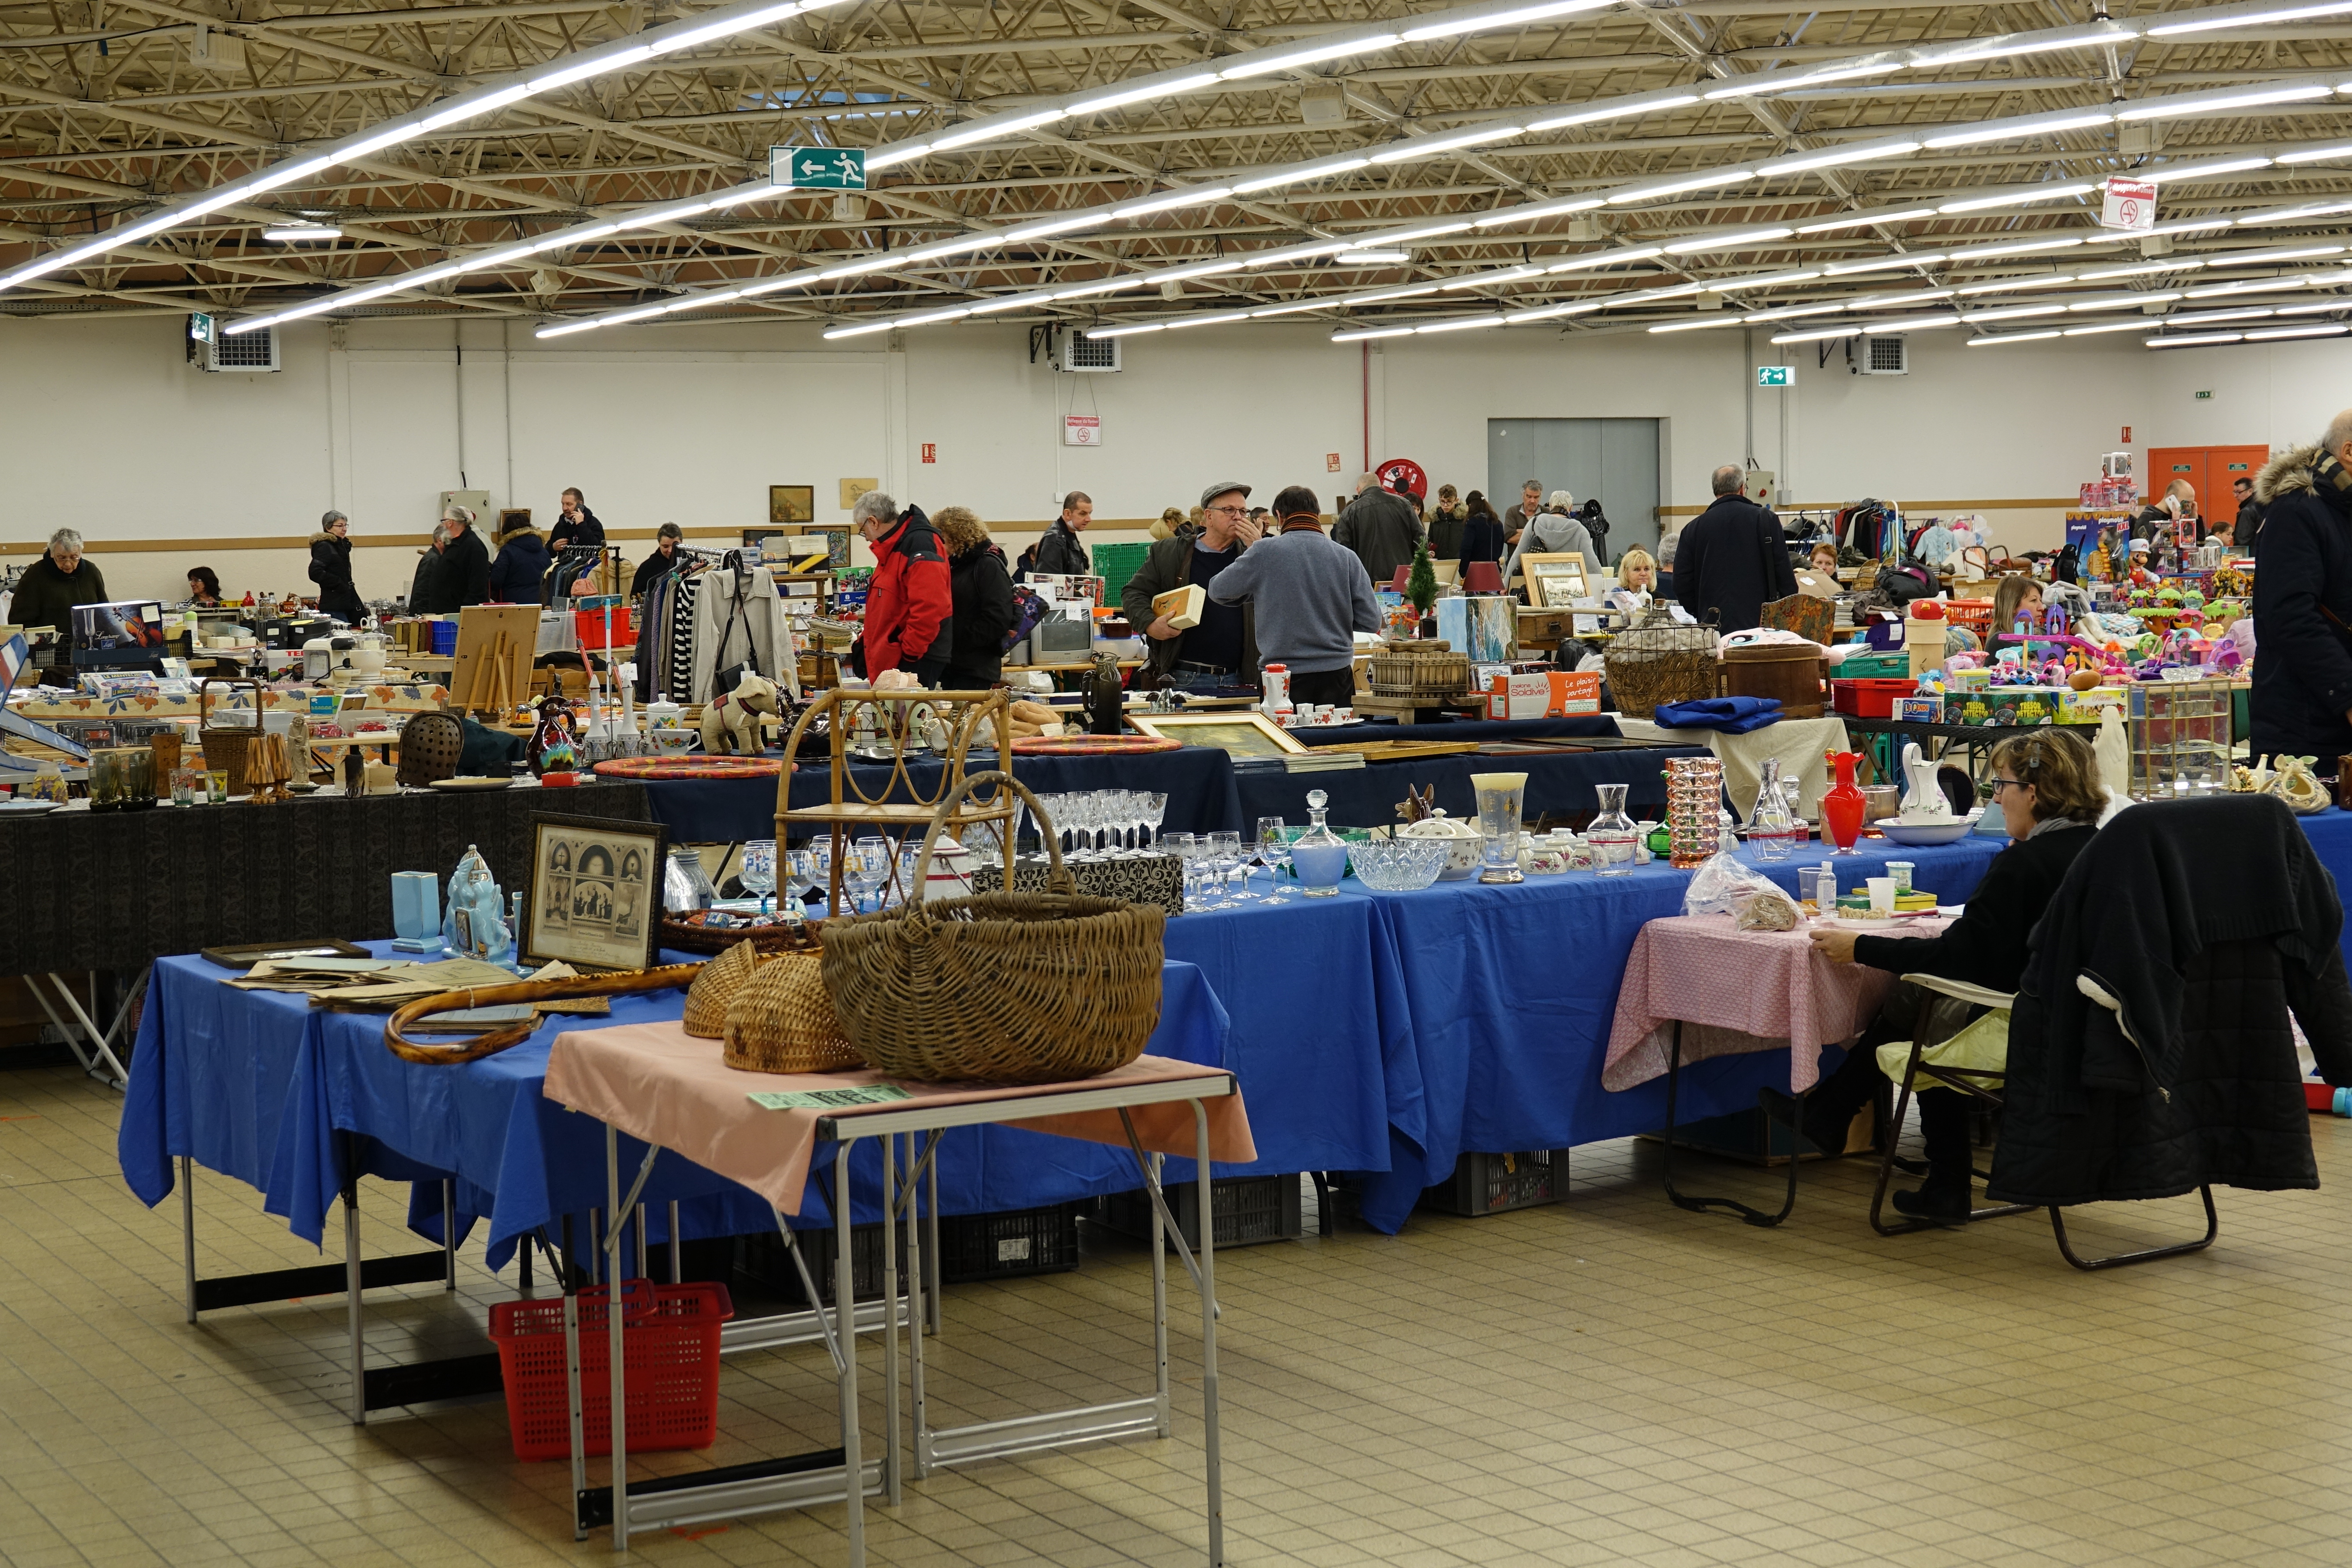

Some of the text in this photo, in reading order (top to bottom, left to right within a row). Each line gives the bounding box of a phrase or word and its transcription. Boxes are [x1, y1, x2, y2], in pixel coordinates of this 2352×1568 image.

[2098, 516, 2124, 525] playmobil
[2117, 522, 2129, 532] XXL
[1565, 677, 1596, 688] Le plaisir
[1511, 688, 1545, 696] Soldive
[2092, 691, 2113, 702] Poterie
[1913, 704, 1929, 712] PENDU
[1966, 701, 1985, 710] TRESOR
[2020, 701, 2041, 710] TRESOR
[1963, 710, 1989, 718] DETECTOR
[2016, 710, 2045, 718] DETECTOR
